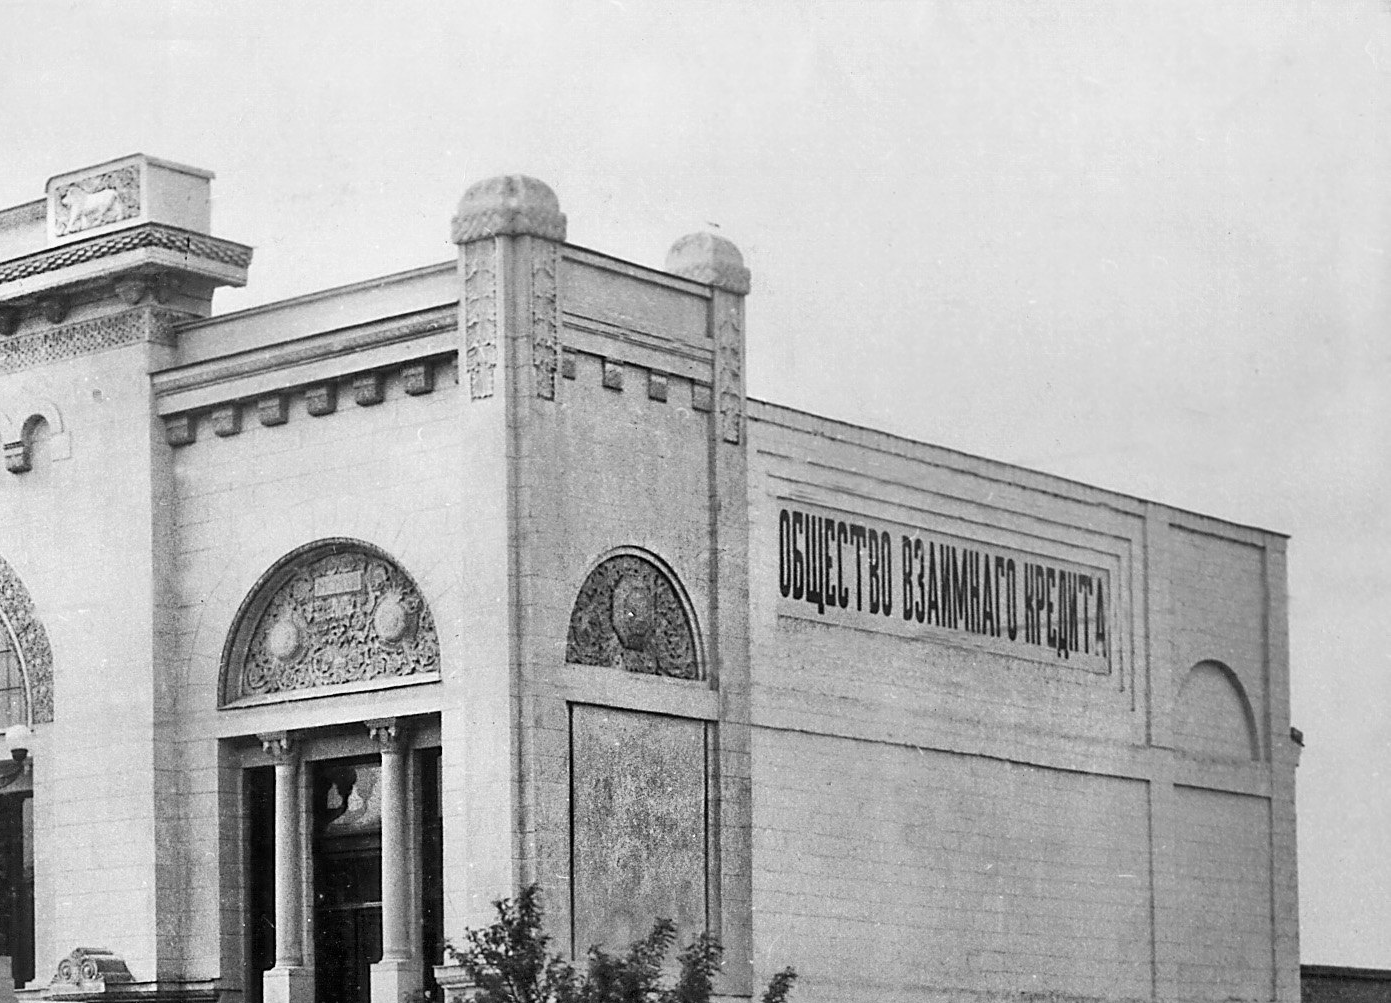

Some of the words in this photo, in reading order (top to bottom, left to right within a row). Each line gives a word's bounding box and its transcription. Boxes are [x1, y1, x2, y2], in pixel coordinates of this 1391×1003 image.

[779, 509, 892, 617] ОБЩЕСТВО
[901, 535, 1018, 642] ВЗАИМНАГО
[1024, 562, 1108, 660] КРЕДИТА
